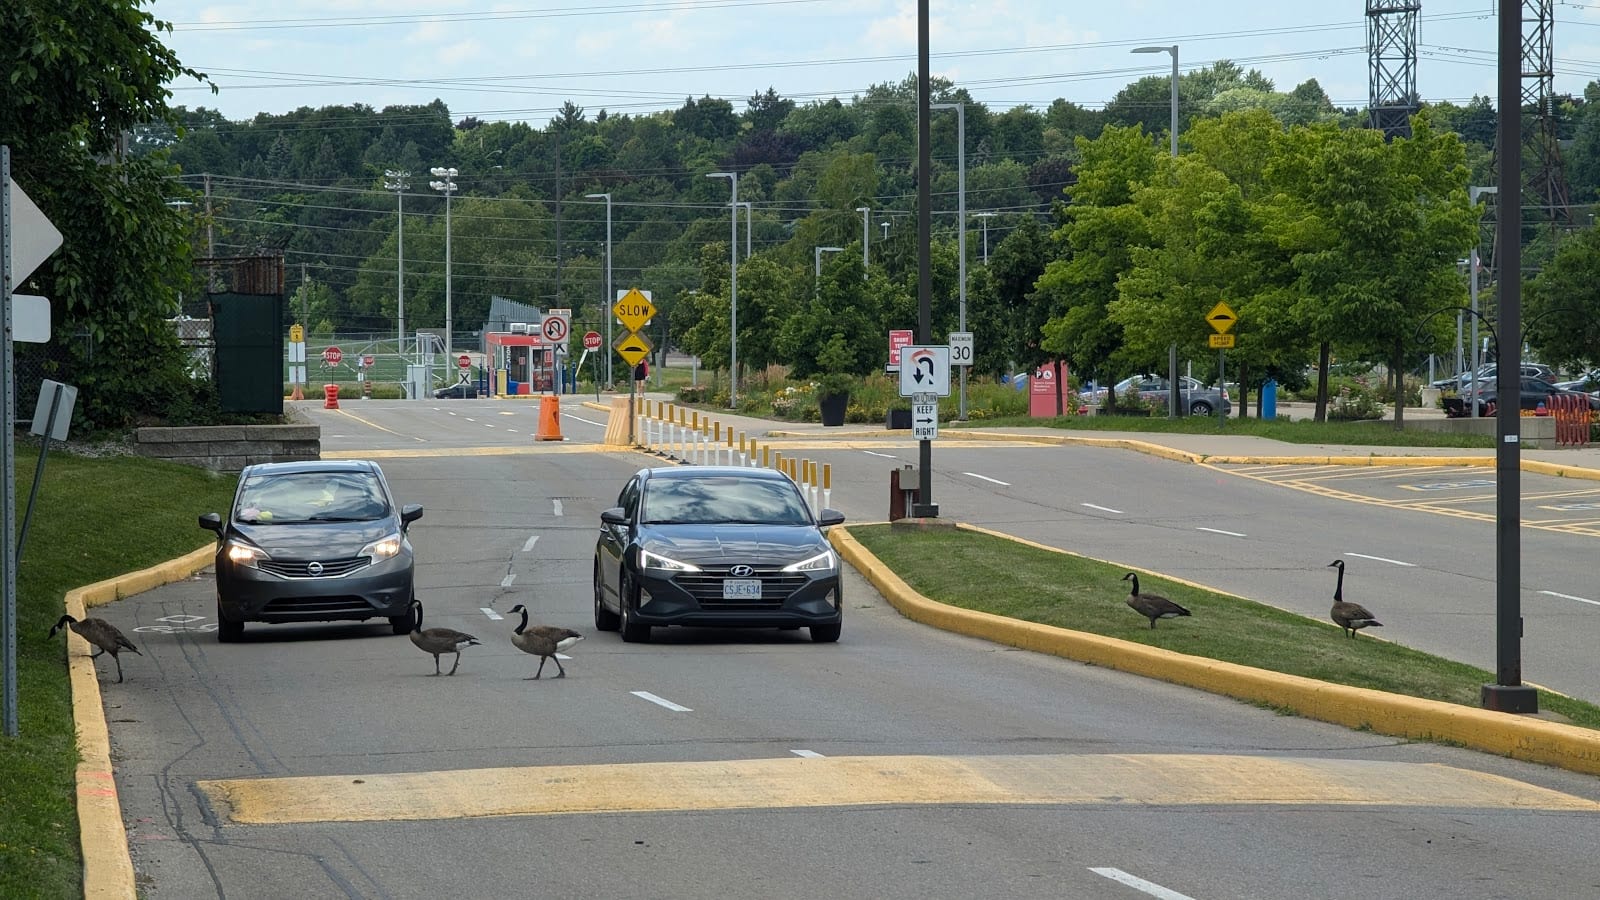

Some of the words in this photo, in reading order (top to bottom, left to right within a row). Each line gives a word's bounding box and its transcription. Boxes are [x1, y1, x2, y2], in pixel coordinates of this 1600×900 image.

[620, 305, 650, 316] SLOW
[585, 337, 600, 345] STOP
[952, 346, 970, 360] 30
[916, 406, 934, 414] KEEP
[916, 428, 935, 436] RIGHT
